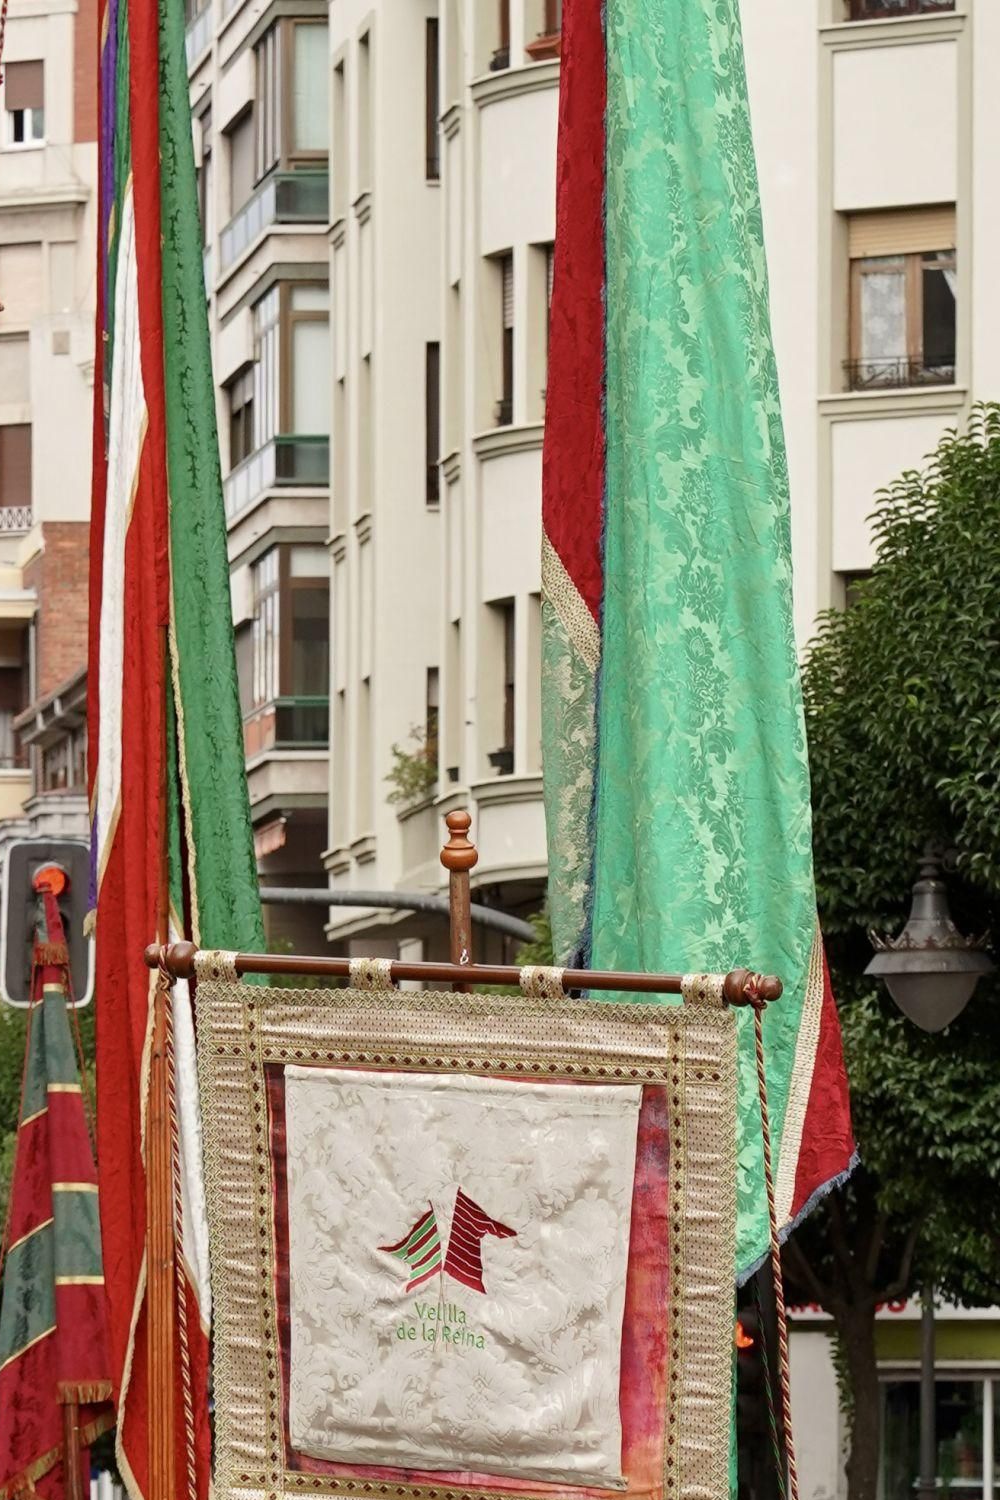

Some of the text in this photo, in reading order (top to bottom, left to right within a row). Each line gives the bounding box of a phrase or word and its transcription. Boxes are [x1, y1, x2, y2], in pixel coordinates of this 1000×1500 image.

[415, 1302, 467, 1324] Velilla
[397, 1323, 486, 1350] de la Reina
